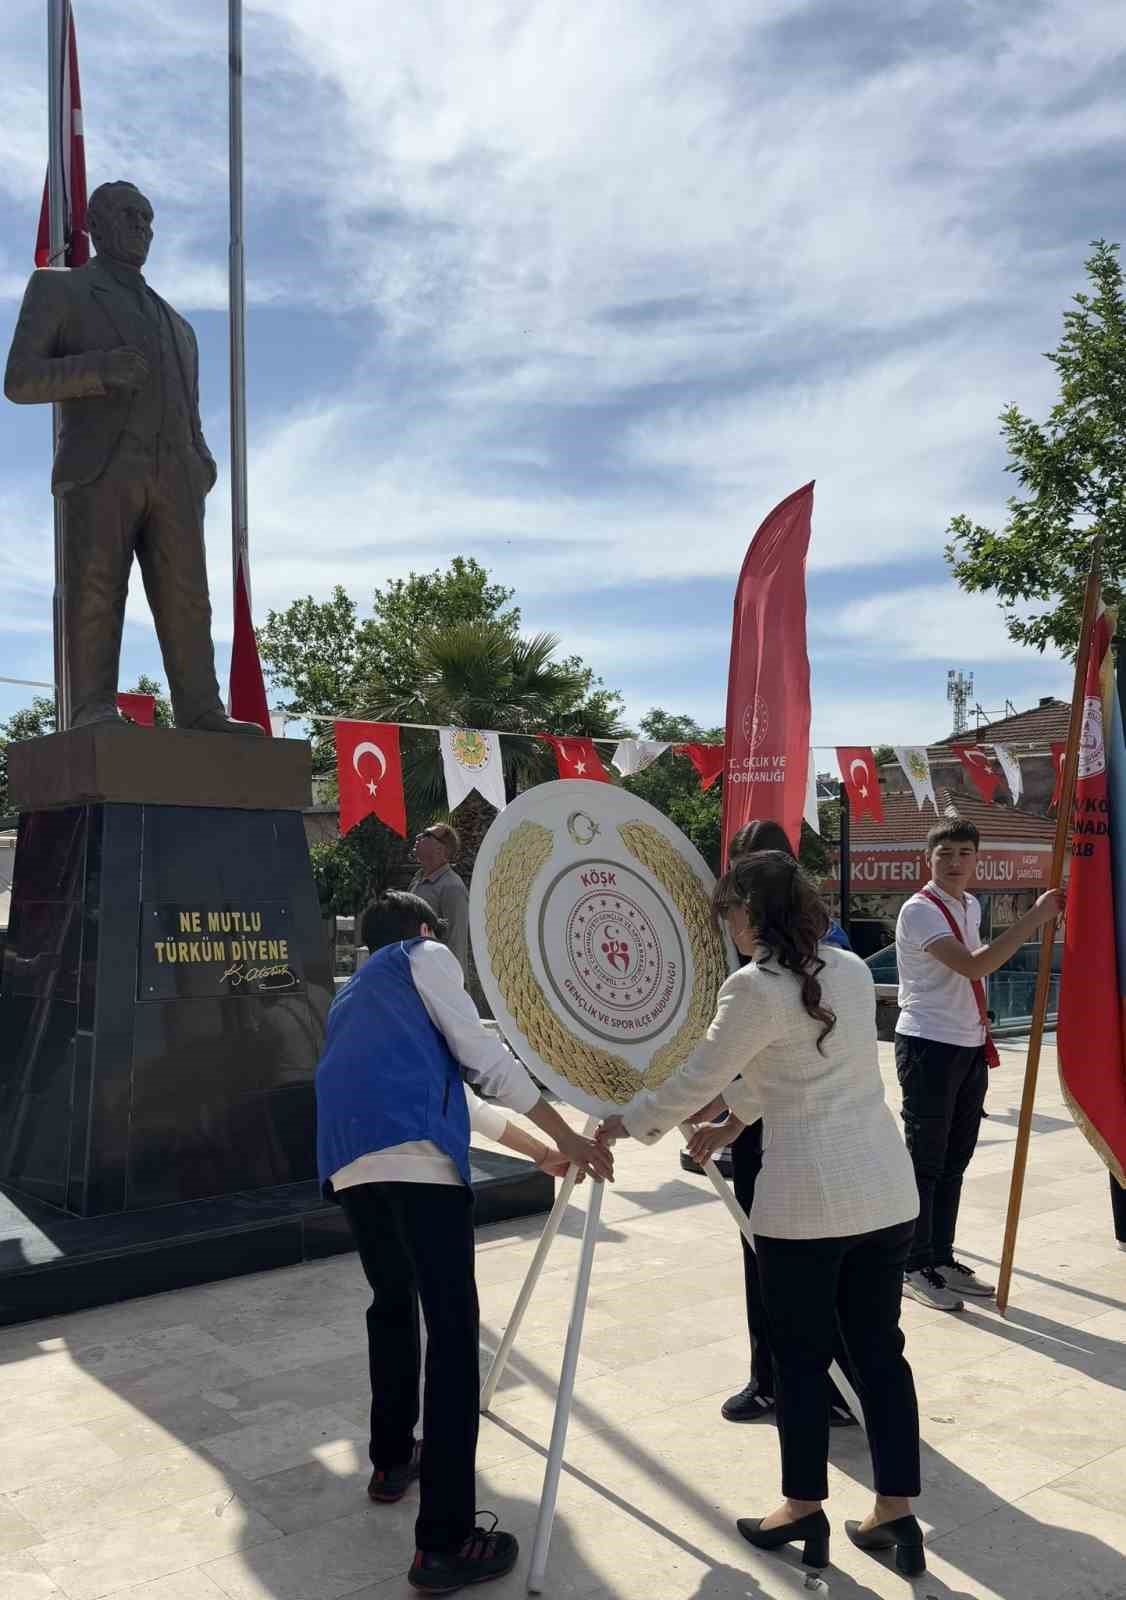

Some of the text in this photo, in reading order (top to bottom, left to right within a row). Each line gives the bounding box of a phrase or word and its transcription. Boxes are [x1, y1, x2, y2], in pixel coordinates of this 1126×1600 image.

[772, 756, 786, 767] VE
[580, 869, 617, 888] KÖŞK
[975, 855, 1014, 881] GÜLSU
[180, 911, 262, 932] NE MUTLU
[155, 935, 288, 963] TÜRKÜM DİYENE
[563, 961, 677, 1030] GENÇLİK VE SPOR İLÇE MÜDÜRLÜĞÜ
